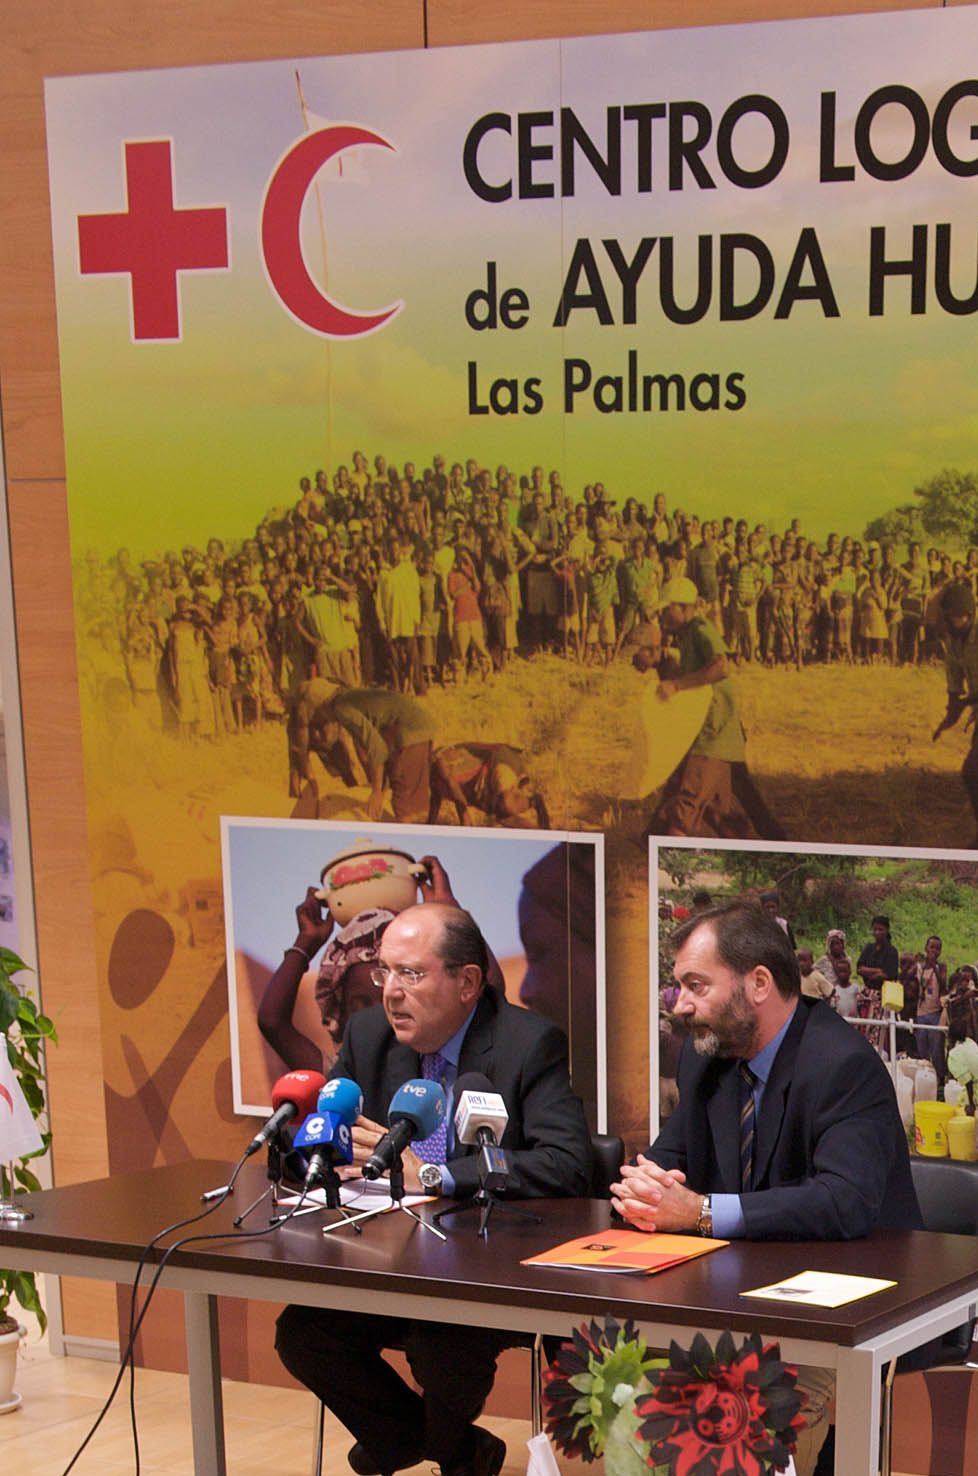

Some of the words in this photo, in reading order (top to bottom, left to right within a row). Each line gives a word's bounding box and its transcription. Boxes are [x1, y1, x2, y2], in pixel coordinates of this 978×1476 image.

[462, 93, 790, 204] CENTRO
[464, 260, 530, 331] de
[553, 226, 840, 329] AYUDA
[468, 360, 544, 417] Las
[563, 350, 747, 414] Palmas
[403, 1084, 427, 1098] tve
